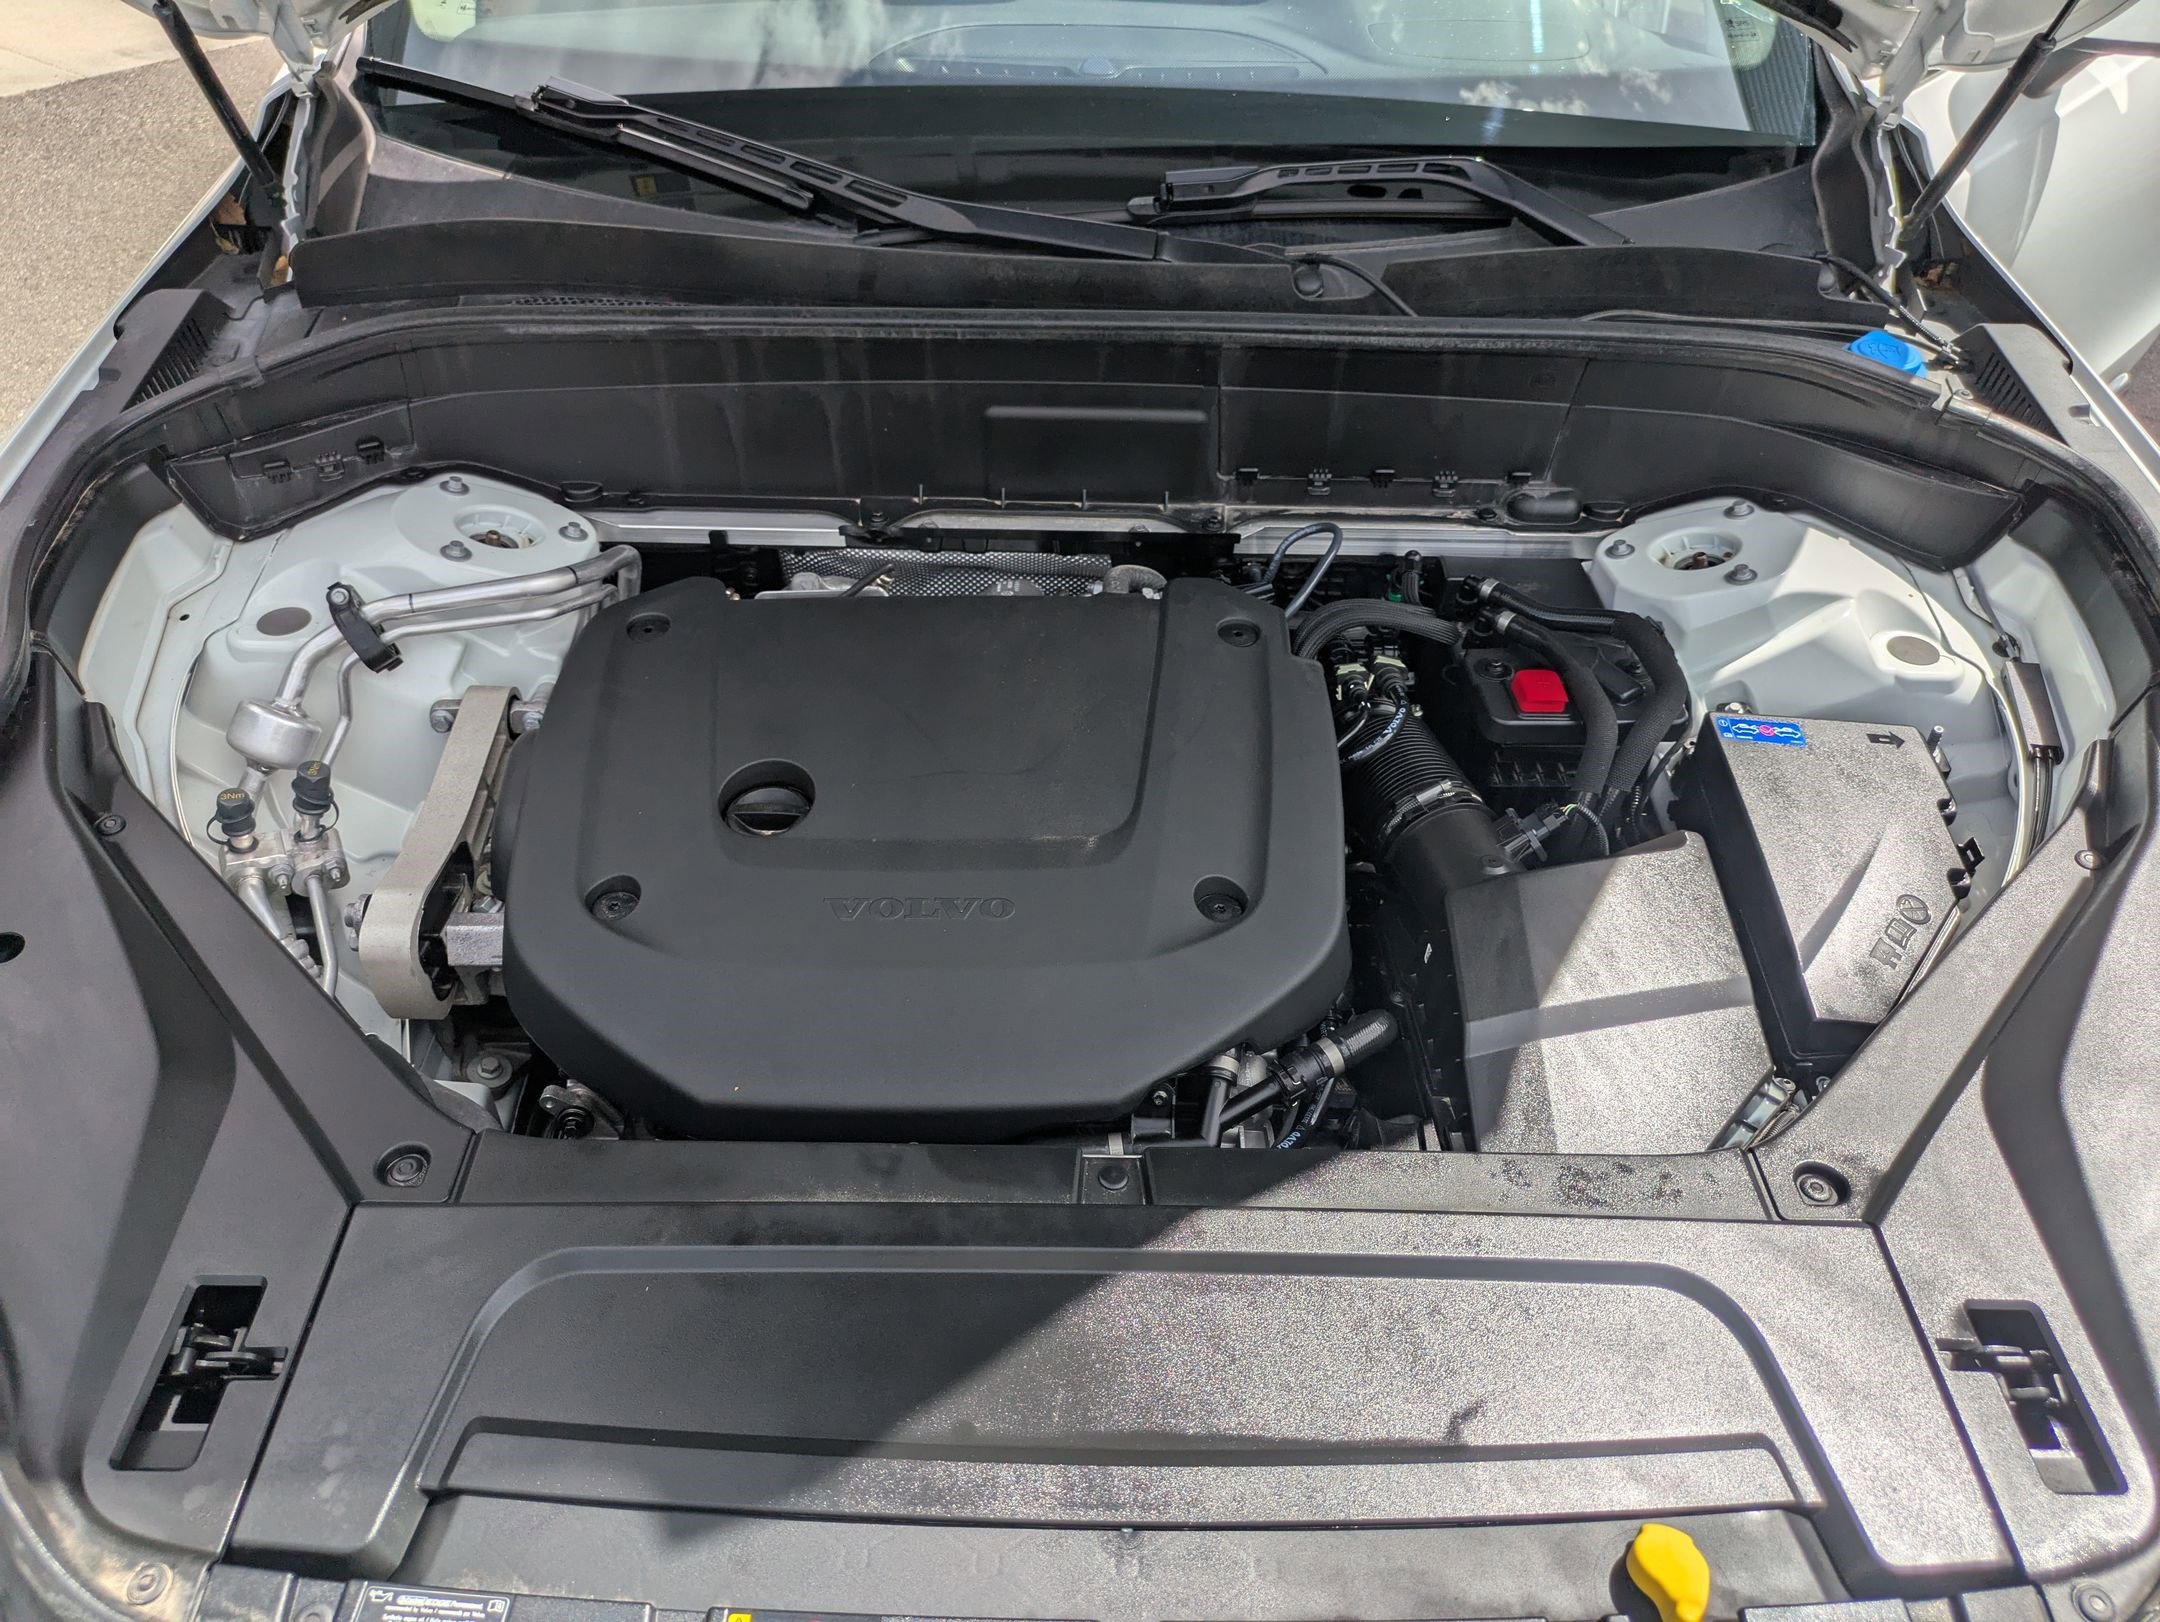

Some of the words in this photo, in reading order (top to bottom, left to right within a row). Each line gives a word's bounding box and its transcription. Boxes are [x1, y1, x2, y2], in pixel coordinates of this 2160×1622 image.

[1382, 707, 1406, 735] VOLVO
[220, 791, 245, 801] 3Nm
[823, 897, 1016, 920] VOLVO
